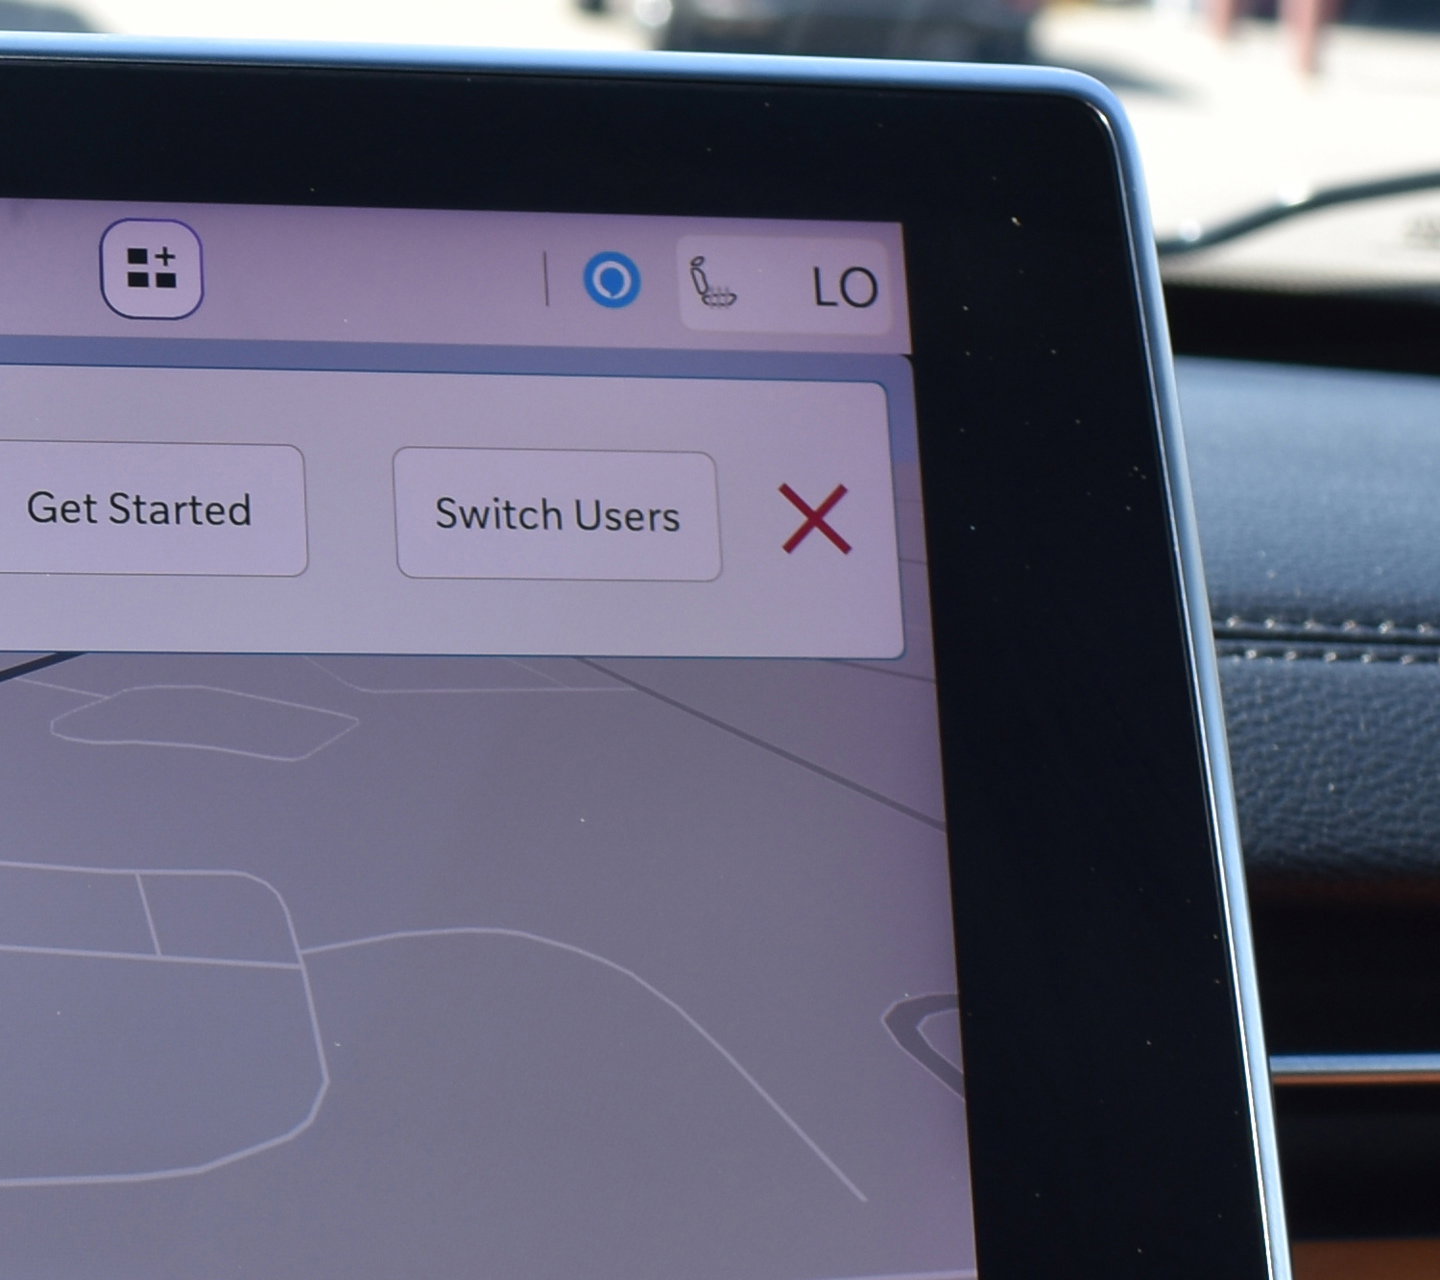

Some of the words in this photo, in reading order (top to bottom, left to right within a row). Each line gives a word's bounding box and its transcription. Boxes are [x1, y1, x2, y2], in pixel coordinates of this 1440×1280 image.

[813, 266, 879, 309] LO
[27, 491, 98, 524] Get
[109, 492, 251, 526] Started
[436, 496, 563, 531] Switch
[575, 499, 680, 532] Users
